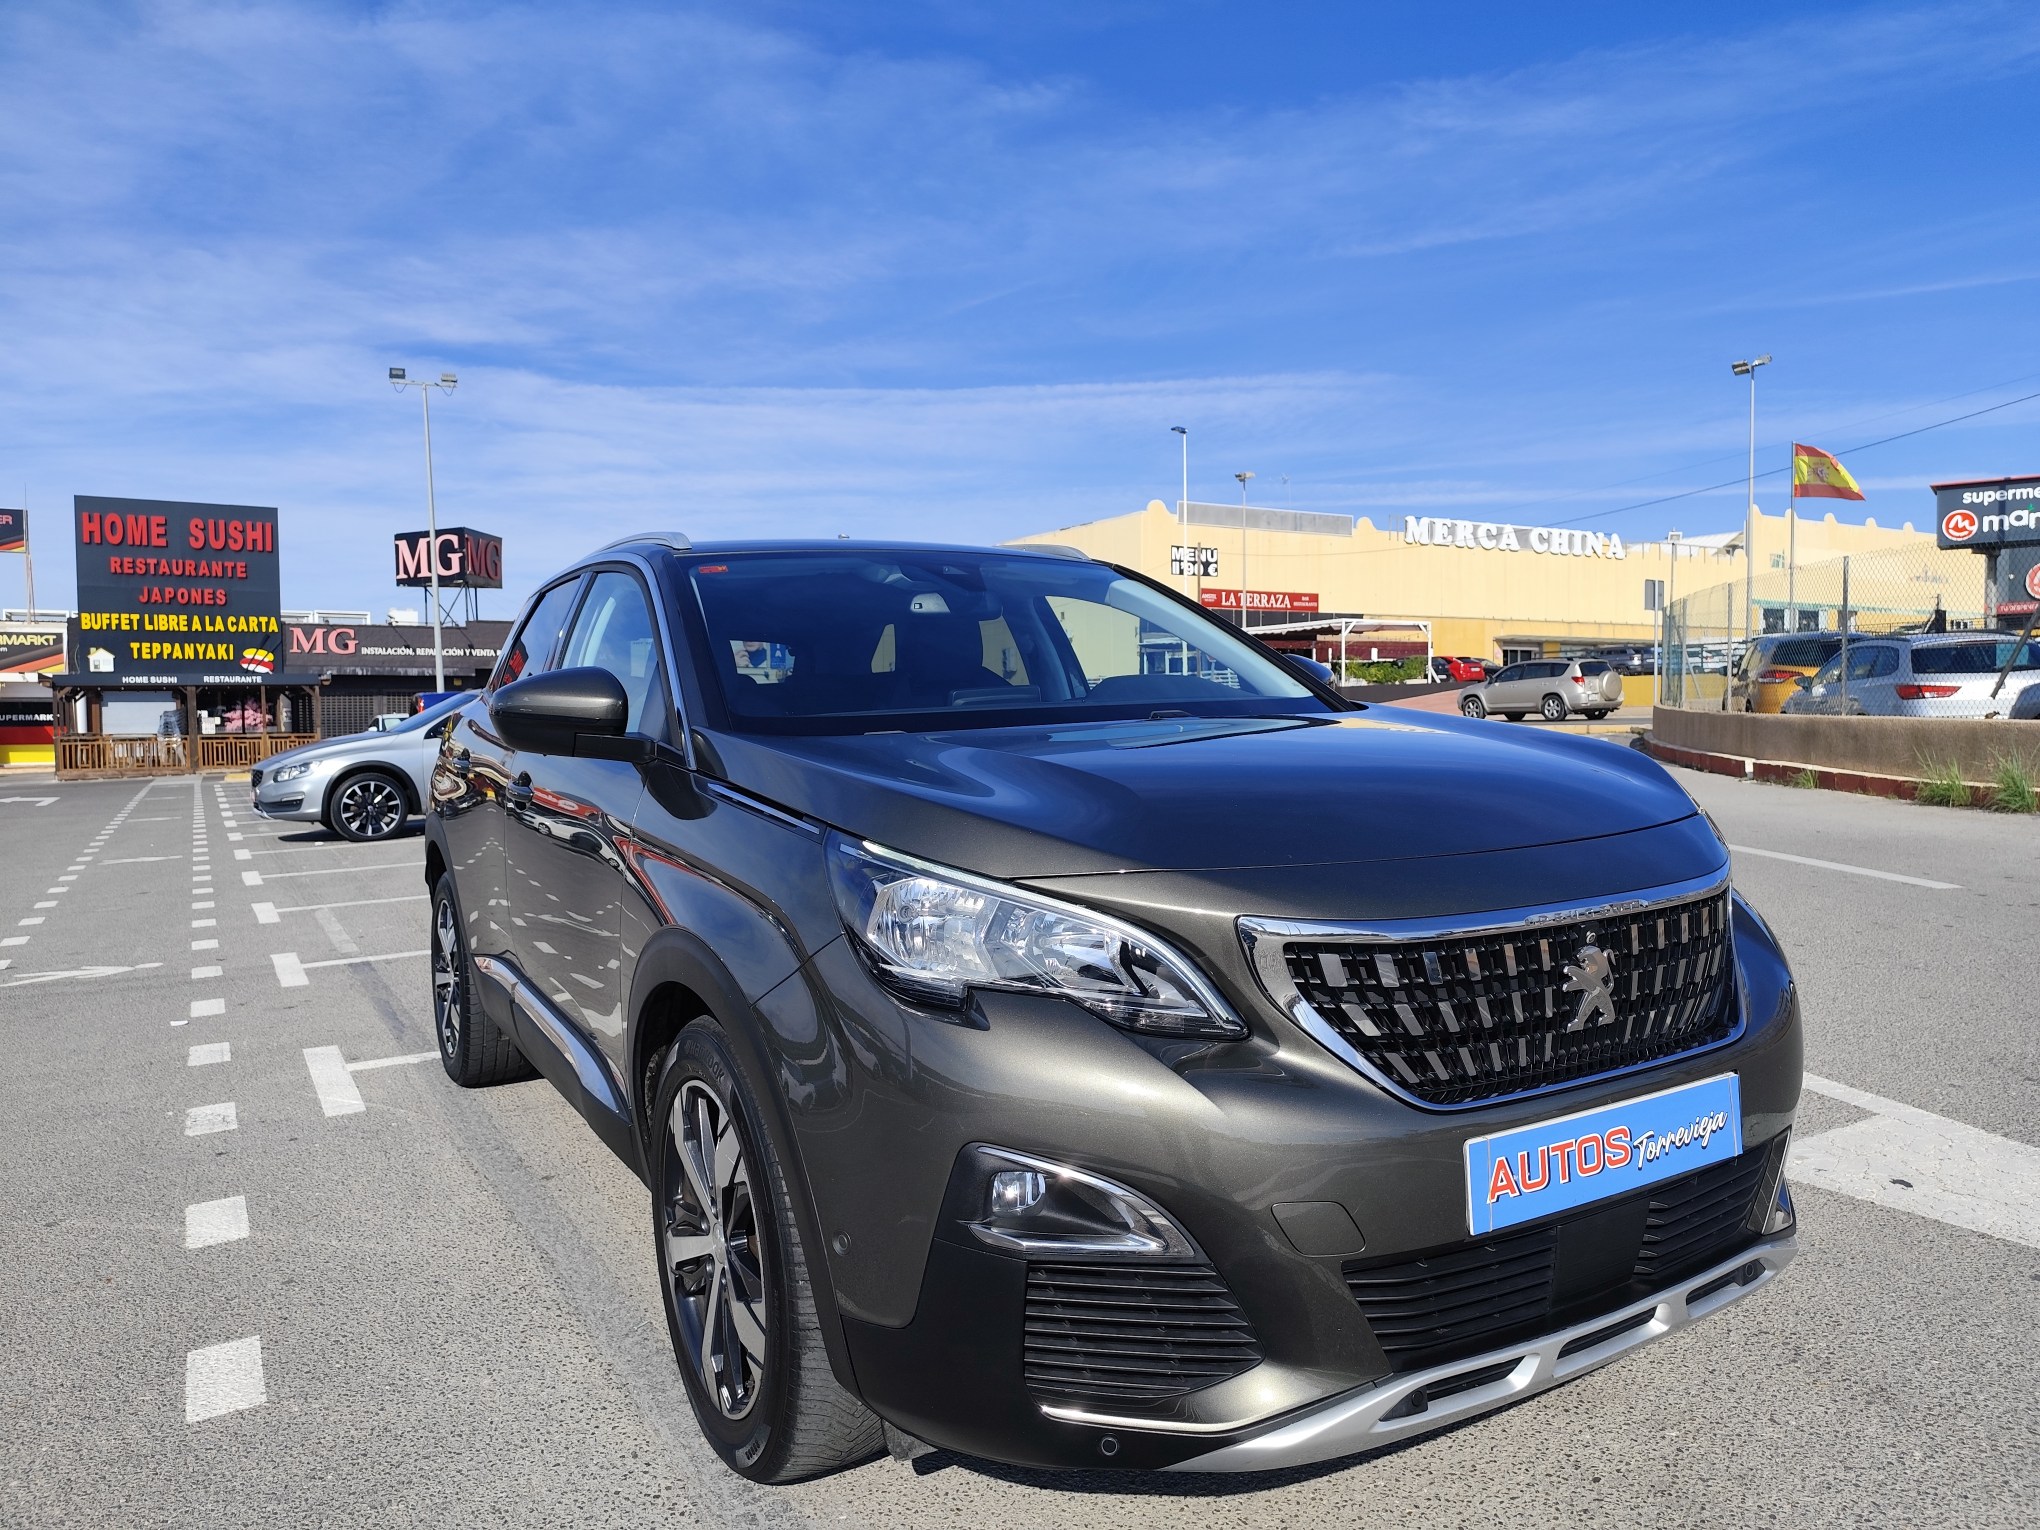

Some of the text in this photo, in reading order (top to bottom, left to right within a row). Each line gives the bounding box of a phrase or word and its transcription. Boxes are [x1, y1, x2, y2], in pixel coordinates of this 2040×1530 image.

[82, 511, 274, 553] HOME SUSHI
[1404, 515, 1626, 560] MERCA CHINA
[110, 556, 248, 579] RESTAURANTE
[395, 534, 463, 579] MG
[465, 534, 501, 580] MG
[138, 586, 227, 605] JAPONES
[1221, 592, 1291, 608] LA TERRAZA
[80, 612, 279, 633] BUFFET LIBRE A LA CARTA
[130, 642, 234, 660] TEPPANYAKI
[289, 627, 359, 655] MG
[464, 648, 471, 657] Y
[471, 648, 495, 657] VENTA
[122, 675, 178, 684] HOME SUSHI
[203, 675, 262, 683] RESTAURANTE
[1486, 1110, 1728, 1204] AUTOS Torrevieja
